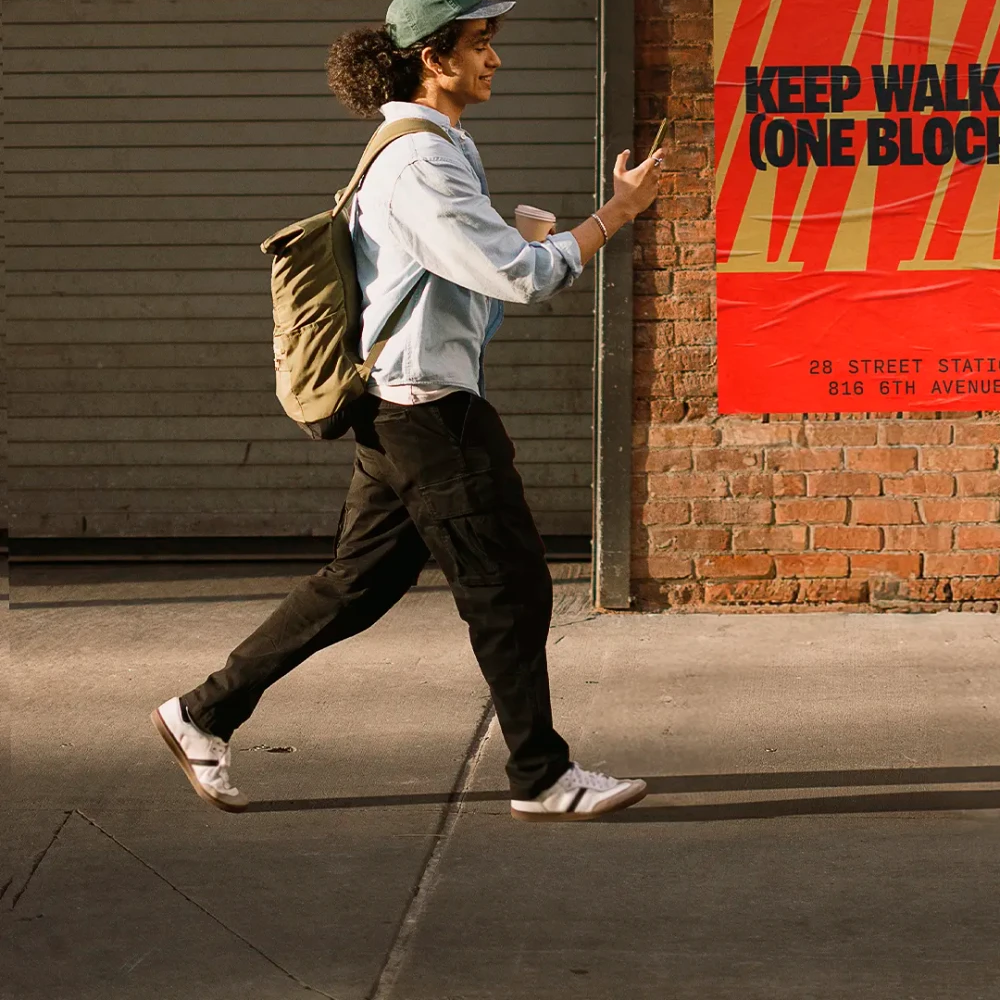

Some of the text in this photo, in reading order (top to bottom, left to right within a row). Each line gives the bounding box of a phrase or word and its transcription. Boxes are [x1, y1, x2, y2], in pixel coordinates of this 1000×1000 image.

[744, 65, 861, 114] KEEP
[749, 112, 855, 171] (ONE
[809, 359, 833, 375] 28
[848, 358, 923, 374] STREET
[828, 380, 864, 396] 816
[879, 380, 916, 395] 6TH
